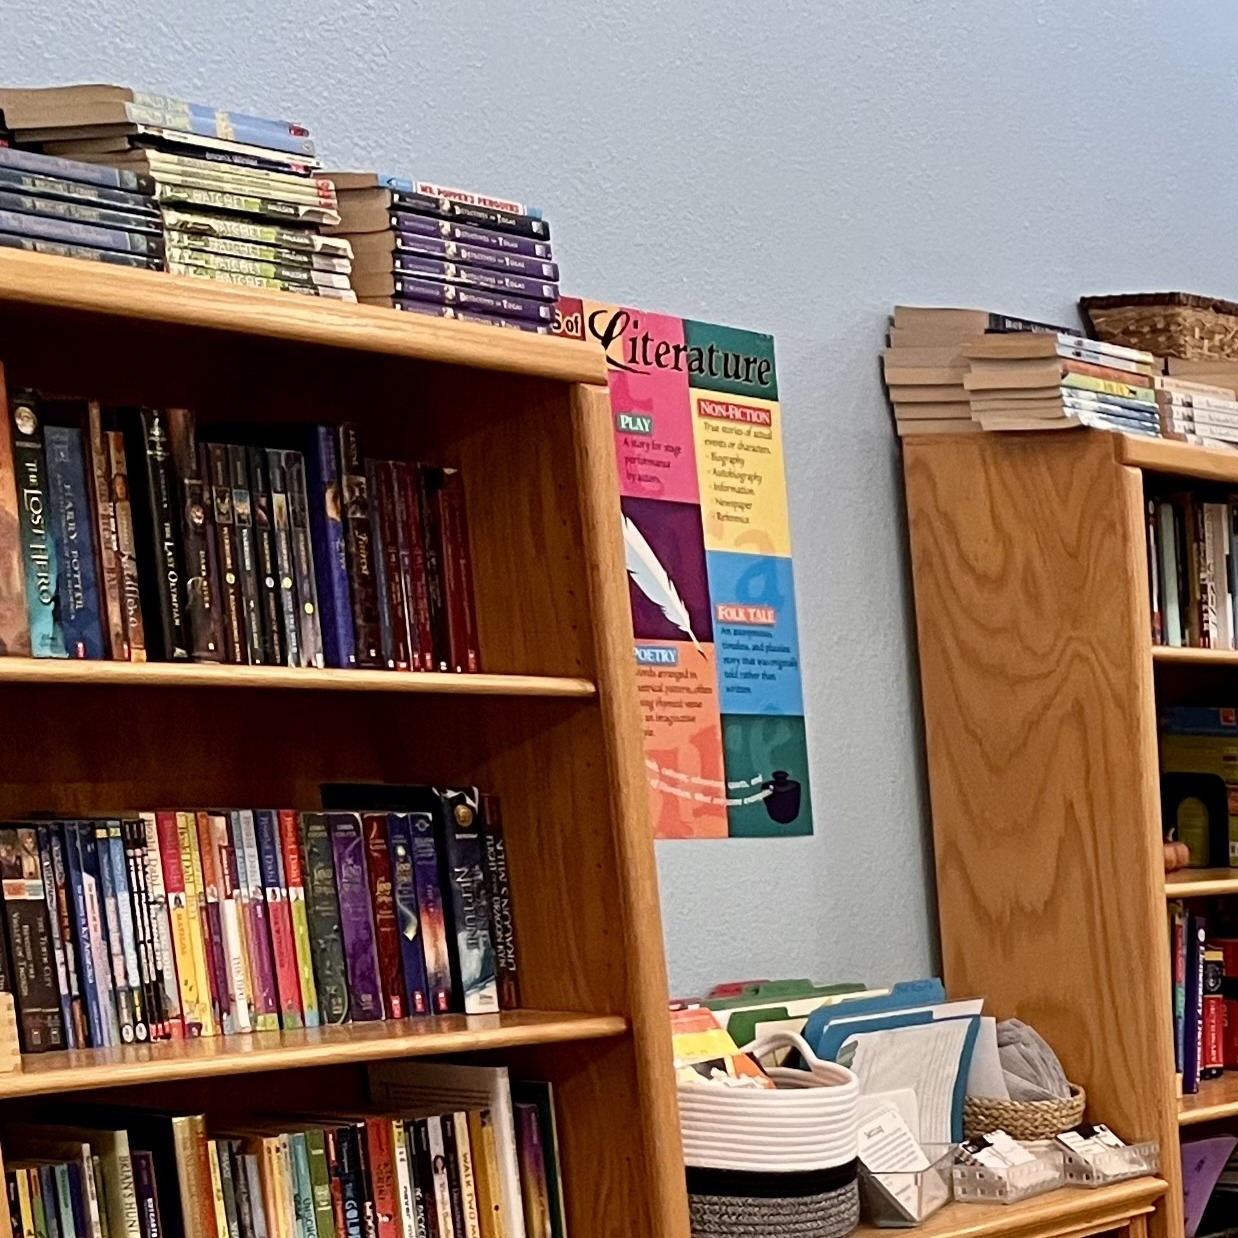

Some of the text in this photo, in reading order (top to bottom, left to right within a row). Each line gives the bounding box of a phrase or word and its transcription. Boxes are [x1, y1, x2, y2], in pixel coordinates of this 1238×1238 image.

[192, 190, 246, 208] HATCHET
[477, 194, 520, 213] PENGUINS
[565, 311, 581, 335] of
[588, 309, 772, 387] Literature
[619, 414, 651, 432] PLAY
[699, 400, 771, 425] NON-FICTION
[24, 488, 46, 540] LOST
[63, 486, 85, 610] HARRY POTTER
[164, 541, 176, 568] LAST
[30, 543, 51, 605] HERO
[166, 570, 182, 627] OLYMPIAN
[717, 606, 775, 622] FOLK TALE
[147, 819, 162, 888] Roald Dahl
[264, 854, 277, 886] Dahl
[182, 860, 194, 886] Dahl
[289, 854, 302, 888] Dahl
[455, 867, 480, 952] NEPTUNE
[491, 896, 505, 936] DRAGON
[11, 911, 22, 943] VALLEY
[177, 912, 188, 958] MATILDA
[44, 966, 53, 989] CITY
[233, 955, 242, 977] THE
[1208, 999, 1217, 1063] DICTIONARY
[118, 1155, 136, 1201] BRIAN'S
[461, 1151, 472, 1187] WALK
[124, 1201, 139, 1234] HUNT
[402, 1185, 413, 1222] never
[466, 1192, 476, 1221] TWO
